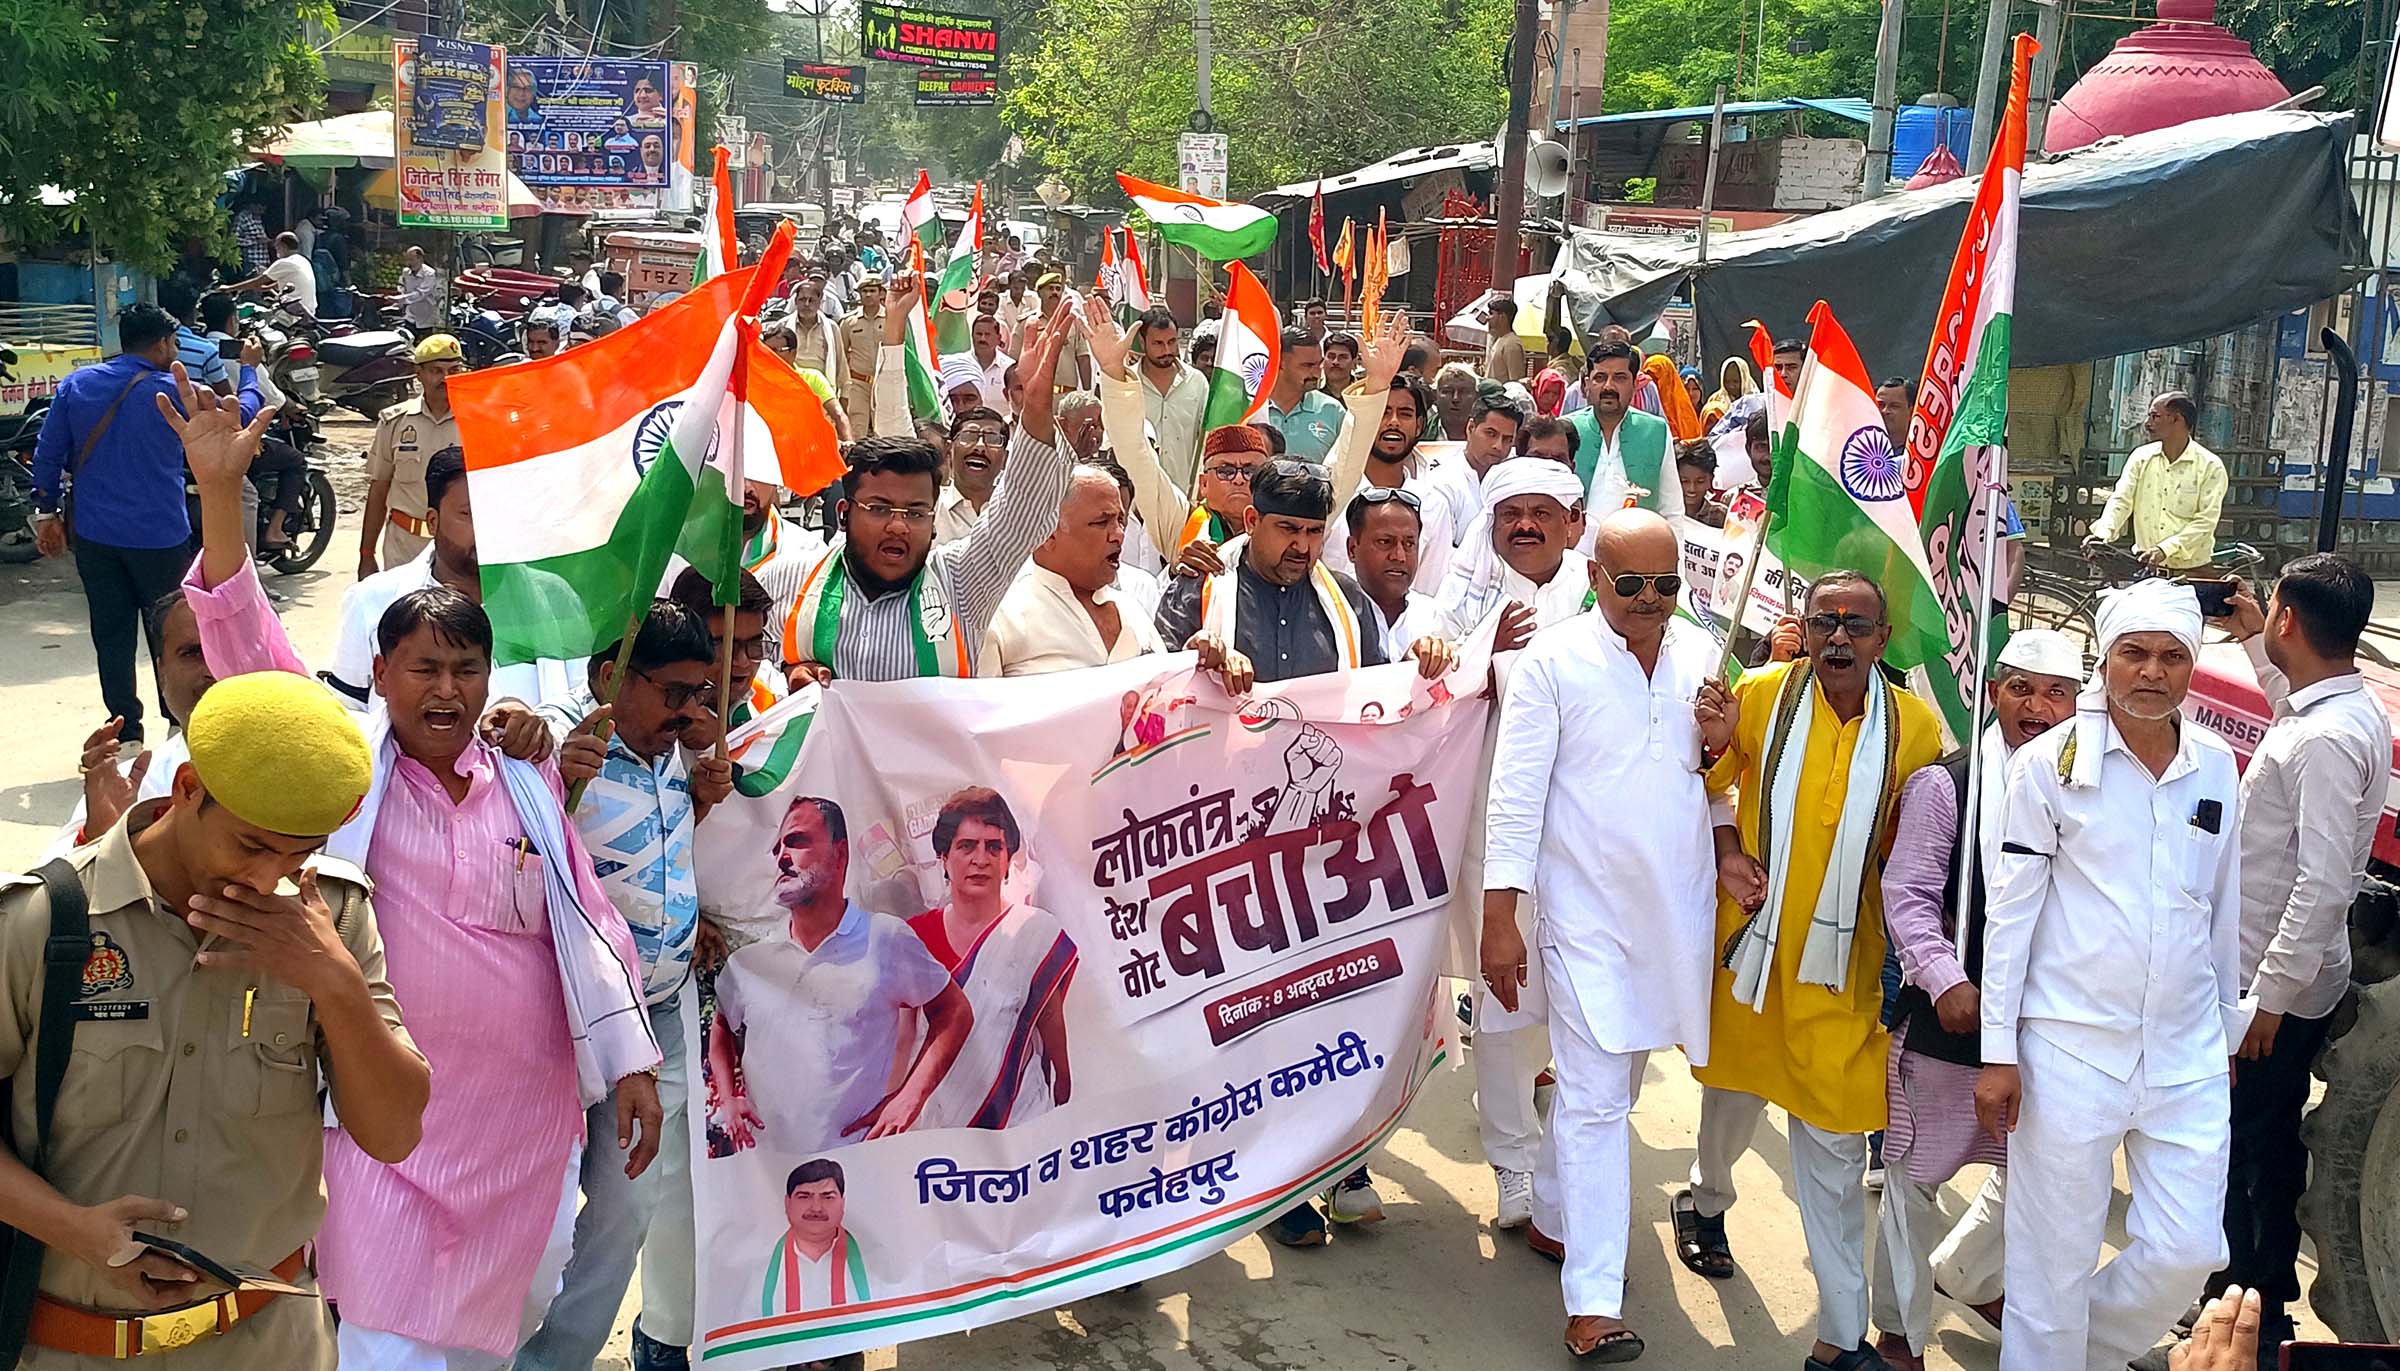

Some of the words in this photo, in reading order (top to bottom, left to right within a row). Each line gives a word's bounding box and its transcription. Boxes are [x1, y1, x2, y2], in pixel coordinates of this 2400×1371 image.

[436, 39, 474, 53] KISNA
[899, 23, 996, 51] SHANVI
[906, 46, 937, 57] COMPLETE
[937, 50, 958, 59] FAMILY
[959, 52, 995, 61] SHOWROOM
[786, 71, 815, 96] मोहन
[816, 77, 852, 95] फुटवियर
[918, 81, 950, 91] DEEPAK
[448, 167, 471, 187] सिंह
[473, 168, 501, 187] सेंगर
[1091, 784, 1236, 889] लोकतंत्र
[1104, 896, 1150, 941] देश
[1148, 772, 1449, 980] बचाओ
[1118, 948, 1166, 1000] वोट
[1217, 994, 1262, 1027] दिनांक
[1273, 988, 1283, 1006] 8
[1287, 971, 1335, 1002] अक्टूबर
[1337, 955, 1380, 981] 2026
[915, 1158, 1030, 1204] जिला
[1039, 1153, 1064, 1185] व
[1068, 1122, 1157, 1172] शहर
[1165, 1079, 1265, 1143] कांग्रेस
[1270, 1032, 1387, 1102] कमेटी,
[1098, 1151, 1240, 1220] फतेहपुर
